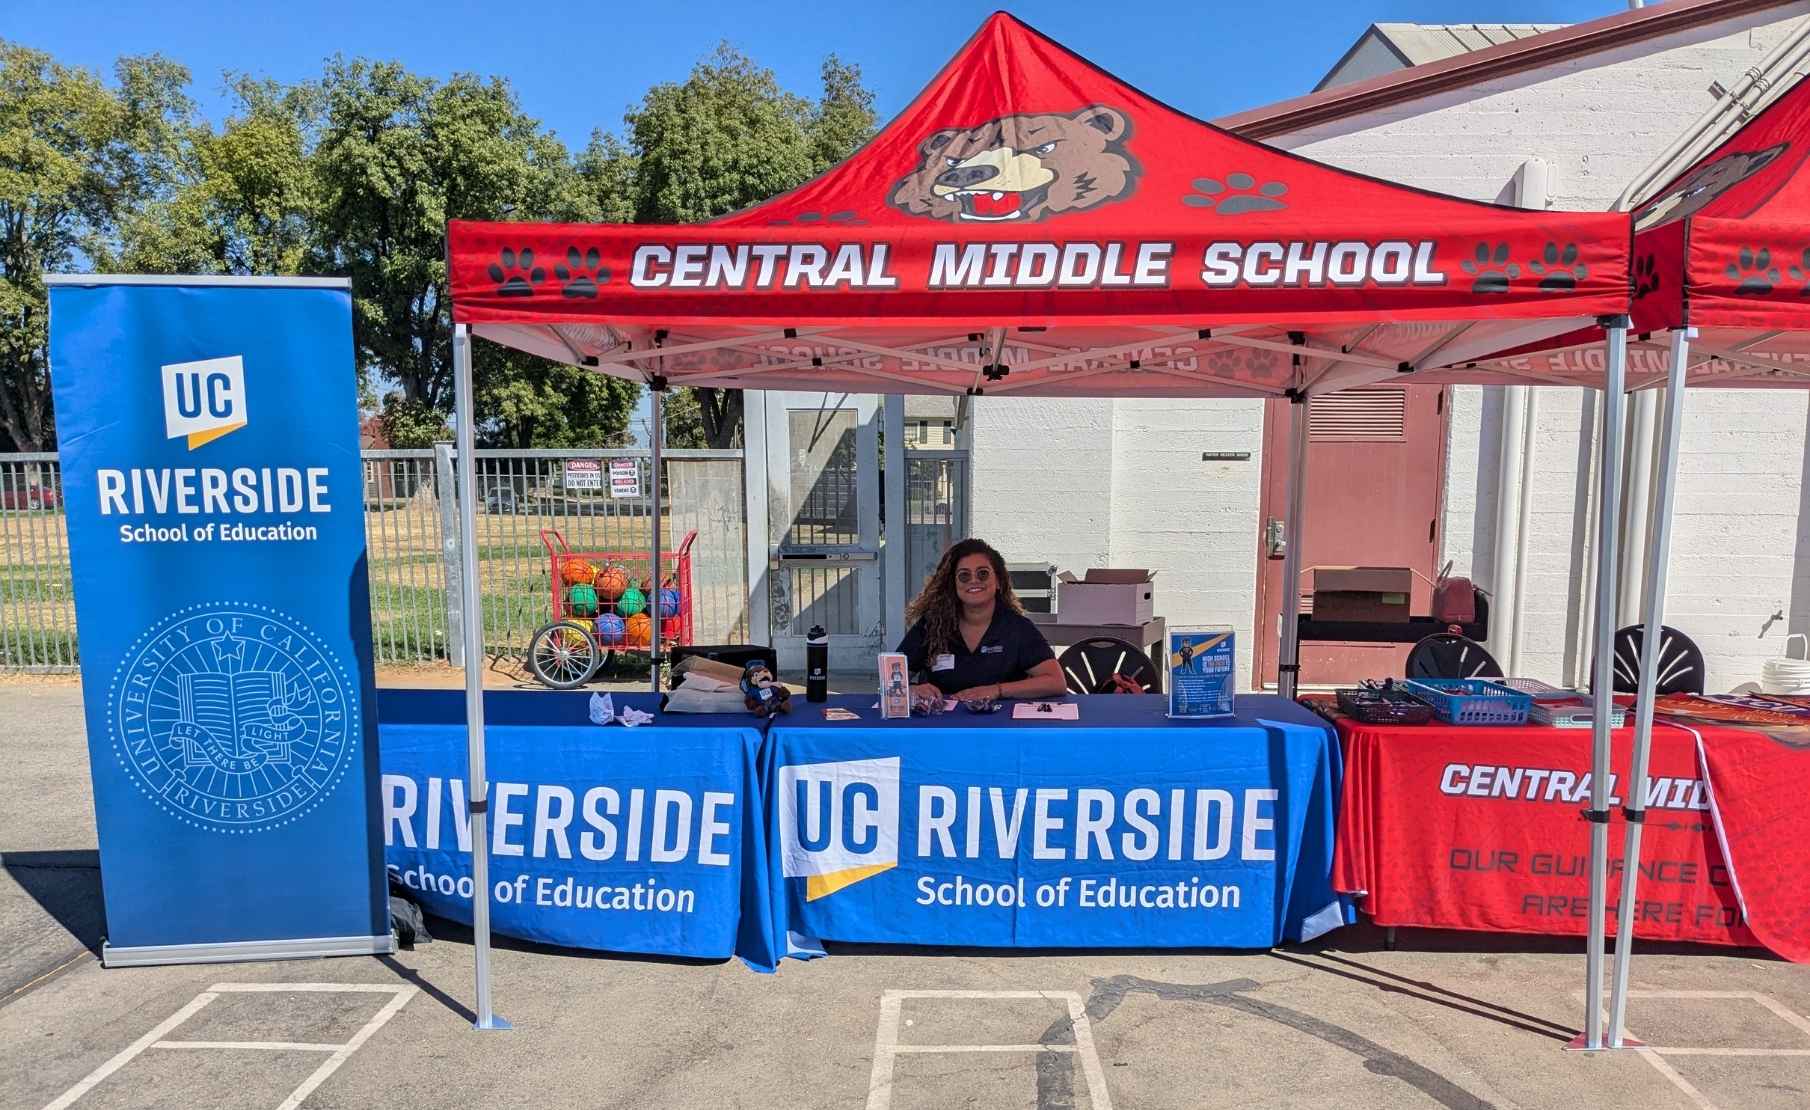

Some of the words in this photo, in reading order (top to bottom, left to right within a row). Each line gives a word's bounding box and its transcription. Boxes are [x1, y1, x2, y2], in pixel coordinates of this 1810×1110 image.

[629, 243, 898, 289] CENTRAL
[927, 242, 1175, 289] MIDDLE
[1200, 241, 1446, 287] SCHOOL
[174, 372, 234, 419] UC
[96, 467, 332, 516] RIVERSIDE
[119, 524, 188, 543] School
[193, 524, 214, 542] of
[220, 521, 318, 542] Education
[125, 625, 192, 775] UNIVERSITY
[206, 617, 244, 635] OF
[260, 624, 342, 774] CALIFORNIA
[176, 726, 202, 739] LET
[251, 726, 289, 741] LIGHT
[203, 737, 236, 770] THERE
[243, 758, 261, 770] BE
[175, 782, 308, 819] RIVERSIDE
[796, 778, 880, 856] UC
[381, 773, 736, 867] RIVERSIDE
[916, 784, 1280, 863] RIVERSIDE
[1448, 848, 1521, 875] OUR
[386, 863, 474, 899] Schoo
[494, 874, 531, 905] of
[535, 877, 696, 914] Education
[916, 875, 1026, 909] School
[1040, 876, 1073, 908] of
[1078, 875, 1241, 909] Education
[1521, 894, 1588, 918] ARE
